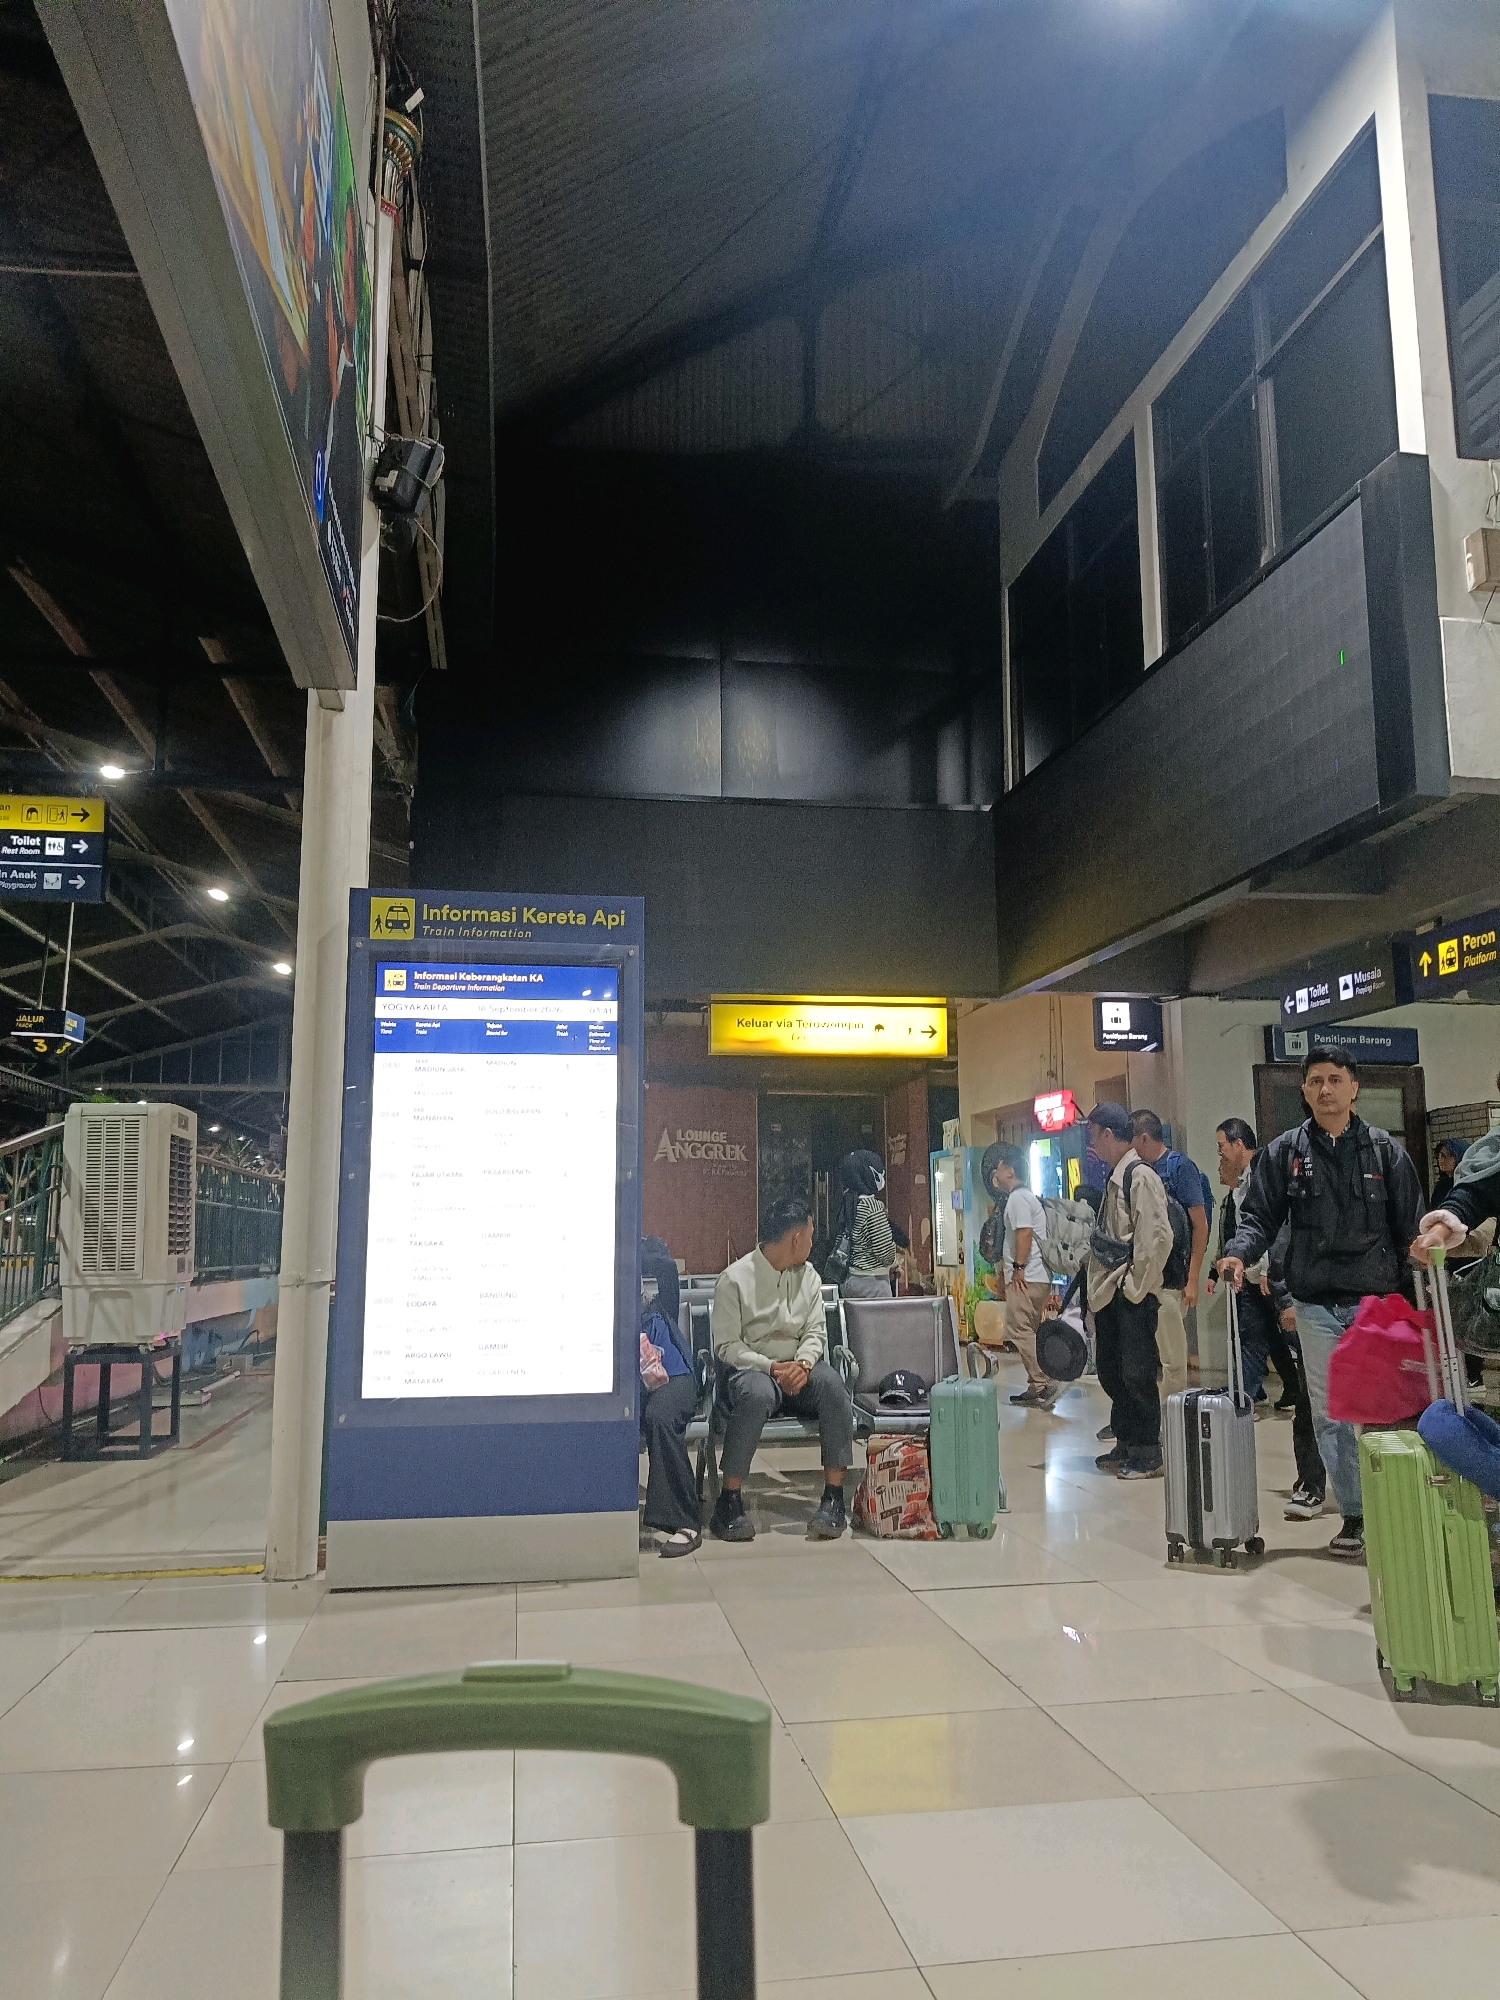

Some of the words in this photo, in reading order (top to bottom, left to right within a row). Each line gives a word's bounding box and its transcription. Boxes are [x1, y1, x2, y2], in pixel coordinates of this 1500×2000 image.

[10, 835, 41, 846] Toilet
[1, 846, 18, 854] Rest
[19, 847, 41, 855] Room
[10, 870, 37, 879] Anak
[422, 904, 516, 922] Informasi
[523, 907, 586, 925] Kereta
[593, 910, 625, 929] Api
[422, 926, 455, 937] Train
[459, 927, 531, 938] Information
[1463, 930, 1496, 951] Peron
[1463, 951, 1497, 968] Platform
[414, 971, 457, 980] Informasi
[459, 972, 527, 983] Keberangkatan
[529, 974, 544, 982] KA
[1353, 966, 1382, 985] Musala
[432, 984, 466, 992] Departure
[467, 984, 505, 992] Information
[1309, 982, 1329, 999] Toilet
[382, 1003, 448, 1012] YOGYAKARTA
[489, 1005, 537, 1014] September
[16, 1014, 45, 1023] JALUR
[737, 1018, 773, 1028] Keluar
[776, 1018, 793, 1028] via
[796, 1019, 864, 1030] Terowongan
[33, 1038, 48, 1053] 3
[1314, 1033, 1357, 1046] Penitipan
[1359, 1035, 1392, 1047] Barang
[677, 1129, 728, 1143] LOUNGE
[653, 1127, 749, 1163] ANGGREK
[407, 1300, 437, 1308] LODAYA
